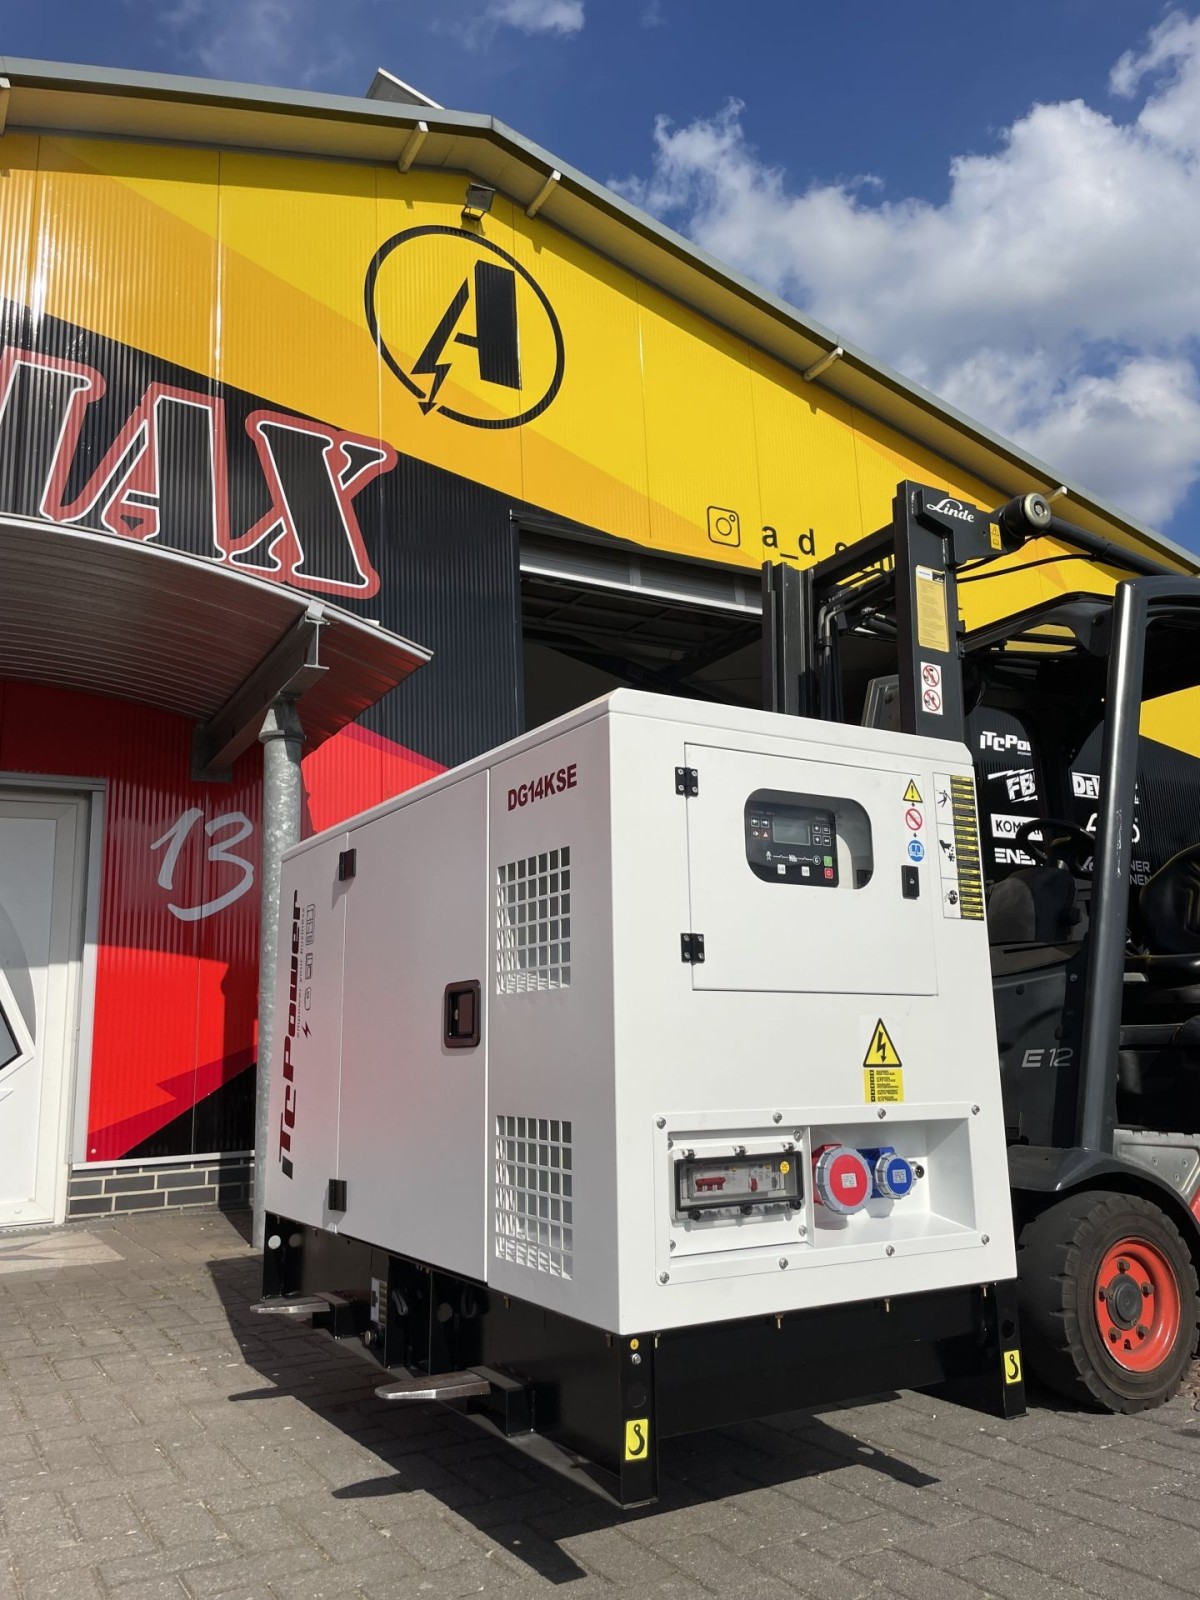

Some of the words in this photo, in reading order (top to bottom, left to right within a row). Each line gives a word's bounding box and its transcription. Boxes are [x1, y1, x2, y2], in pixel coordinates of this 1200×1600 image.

[926, 498, 975, 523] Linde
[507, 763, 578, 812] DG14KSE
[150, 807, 255, 922] 13
